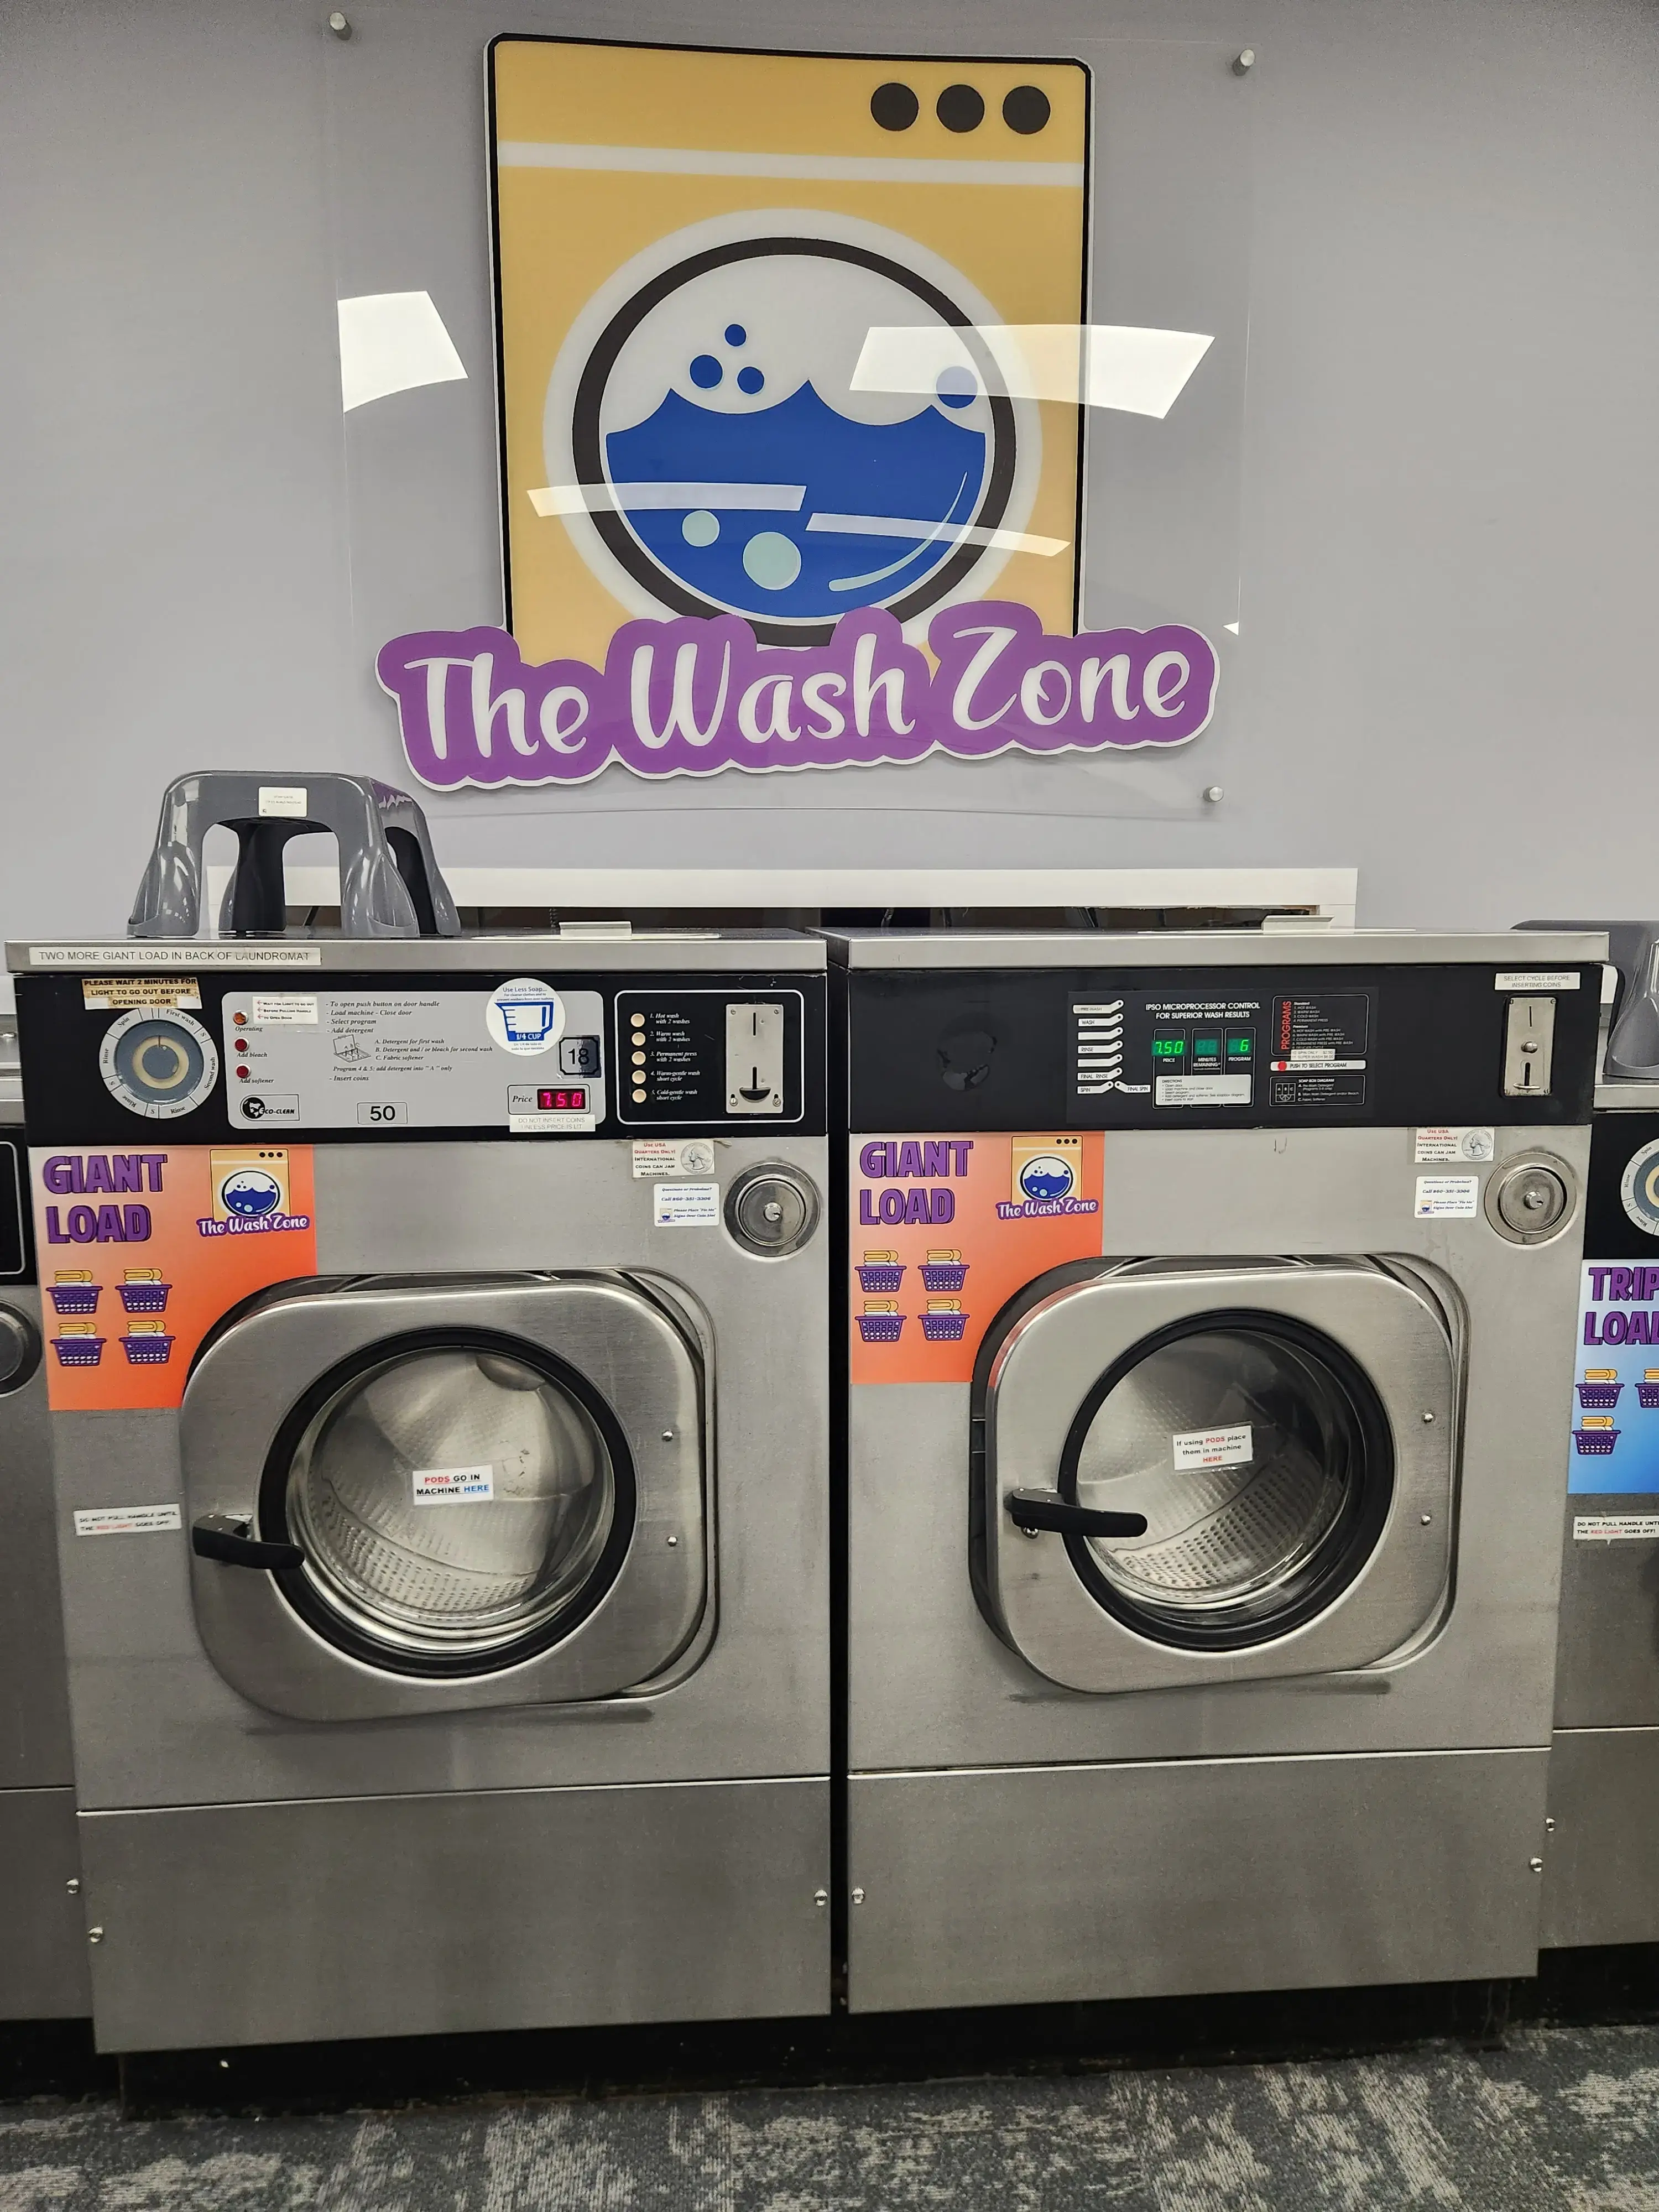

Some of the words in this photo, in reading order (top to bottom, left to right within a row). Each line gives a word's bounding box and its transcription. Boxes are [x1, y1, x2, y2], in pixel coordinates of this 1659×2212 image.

[404, 651, 590, 760] The
[631, 632, 915, 748] Wash
[951, 625, 1191, 724] Zone
[39, 952, 64, 960] TWO
[68, 952, 100, 960] MORE
[103, 952, 136, 960] GIANT
[139, 952, 168, 960] LOAD
[172, 952, 181, 960] IN
[185, 952, 214, 960] BACK
[236, 952, 309, 961] LAUNDROMAT
[117, 1017, 130, 1027] Spin
[166, 1009, 180, 1018] First
[181, 1014, 195, 1026] wash
[1281, 1001, 1291, 1050] PROGRAMS
[1240, 1039, 1249, 1051] 6
[568, 1048, 589, 1065] 18
[204, 1070, 215, 1089] Second
[369, 1106, 395, 1122] 50
[859, 1140, 974, 1178] GIANT
[42, 1154, 168, 1194] GIANT
[859, 1188, 955, 1225] LOAD
[998, 1204, 1022, 1218] The
[1025, 1199, 1061, 1215] Wash
[1063, 1198, 1097, 1213] Zone
[45, 1204, 152, 1244] LOAD
[200, 1220, 225, 1235] The
[228, 1215, 269, 1232] Wash
[271, 1215, 307, 1229] Zone
[416, 1486, 461, 1495] MACHINE
